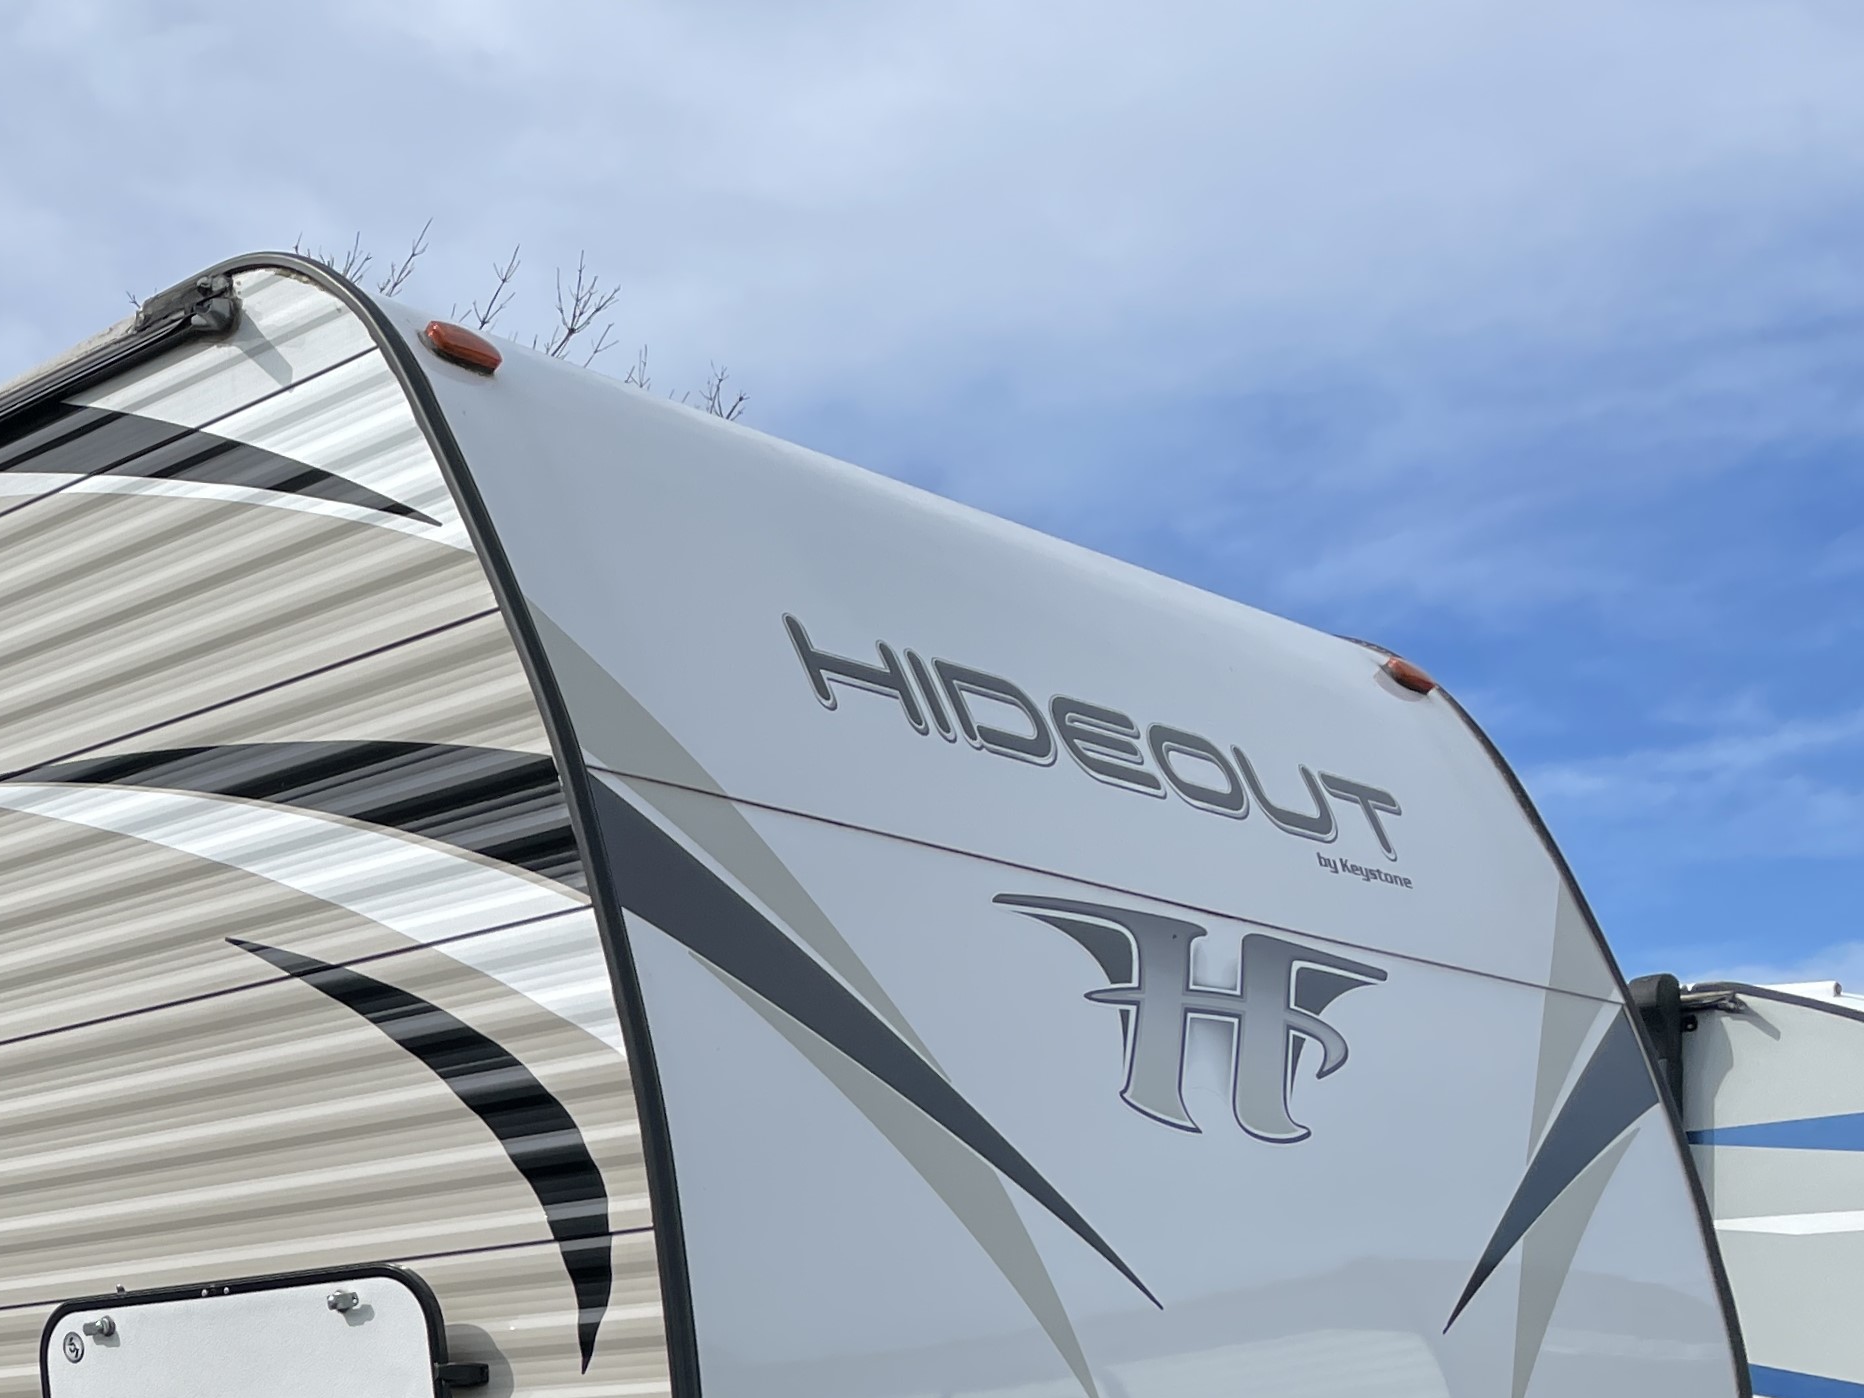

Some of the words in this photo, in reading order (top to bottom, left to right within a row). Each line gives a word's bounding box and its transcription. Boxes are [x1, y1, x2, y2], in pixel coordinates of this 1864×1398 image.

[782, 612, 1401, 862] HIDEOUT
[1316, 851, 1339, 874] by
[1339, 857, 1413, 889] Keystone
